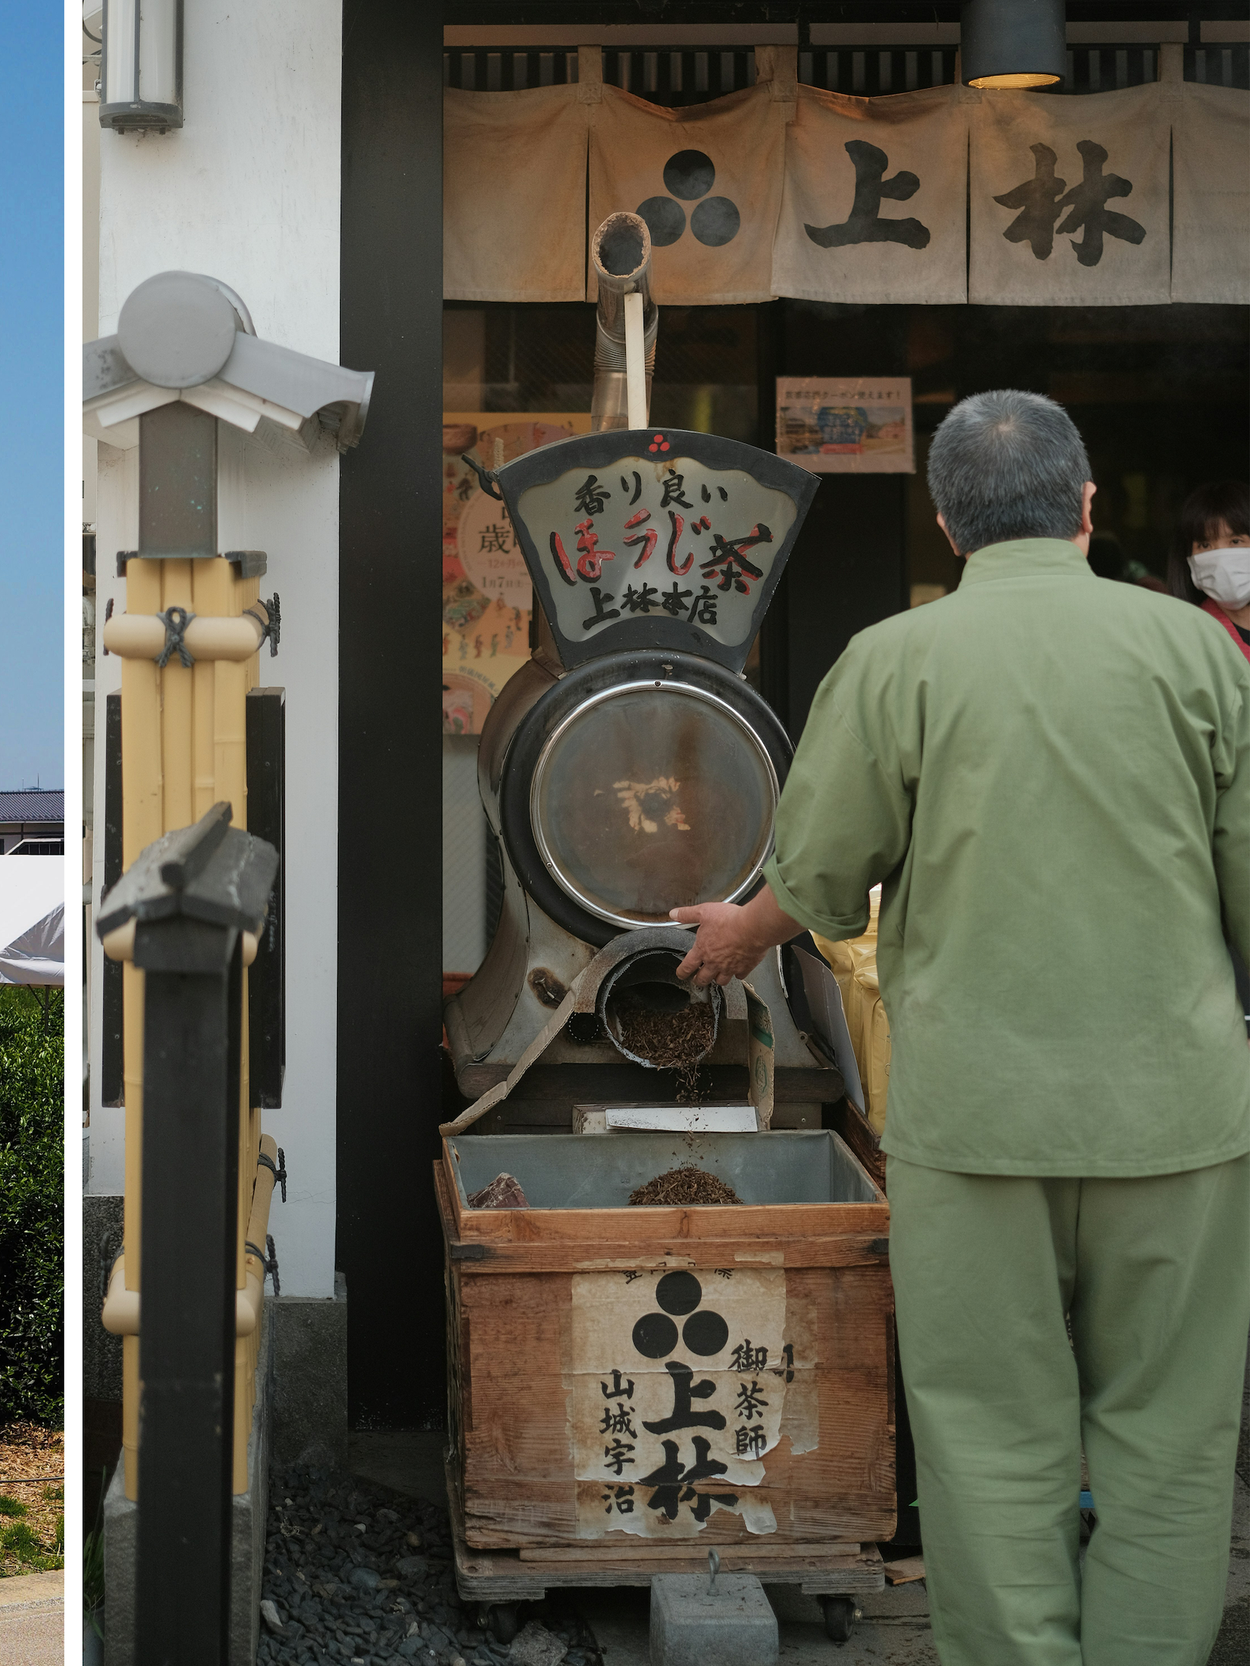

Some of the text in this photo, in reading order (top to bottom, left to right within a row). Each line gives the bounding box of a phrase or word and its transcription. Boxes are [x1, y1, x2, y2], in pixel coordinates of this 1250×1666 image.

[803, 138, 1148, 268] 上林
[574, 470, 729, 517] 香り良い
[549, 508, 774, 595] ほうじ茶
[582, 581, 719, 630] 上林本店
[599, 1368, 638, 1515] 山城宇治
